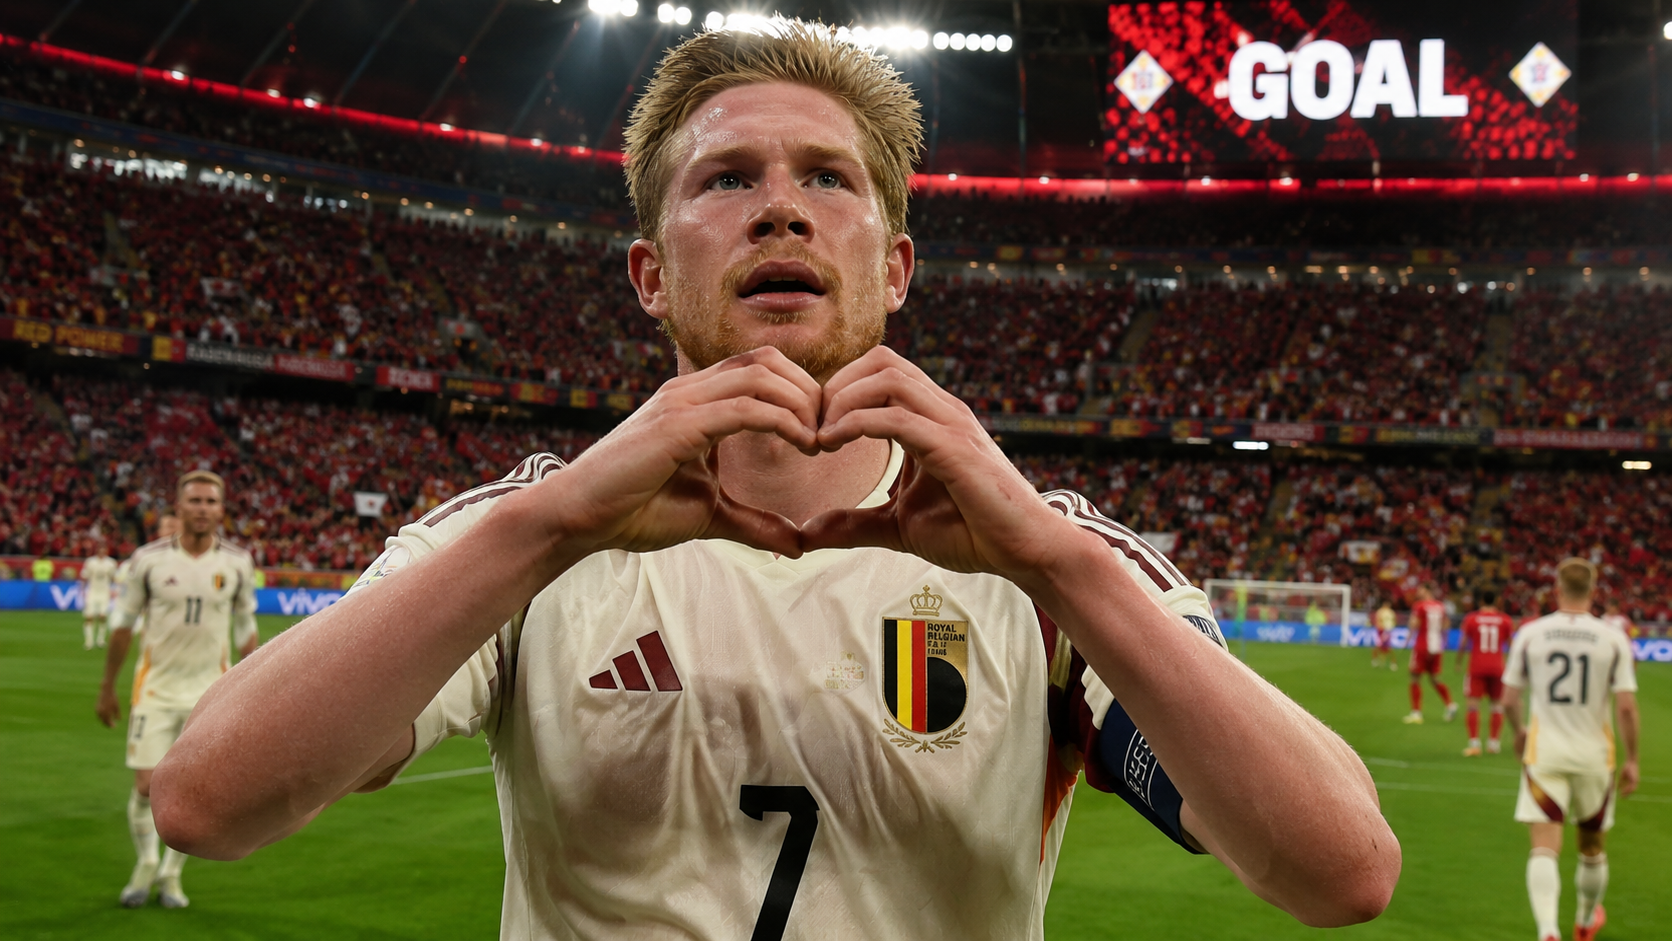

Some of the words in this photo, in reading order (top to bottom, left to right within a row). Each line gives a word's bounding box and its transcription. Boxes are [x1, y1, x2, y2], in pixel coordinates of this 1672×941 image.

[1228, 38, 1468, 121] GOAL
[184, 596, 202, 625] 11
[927, 622, 957, 632] ROYAL
[1547, 651, 1589, 704] 21
[739, 785, 820, 941] 7
